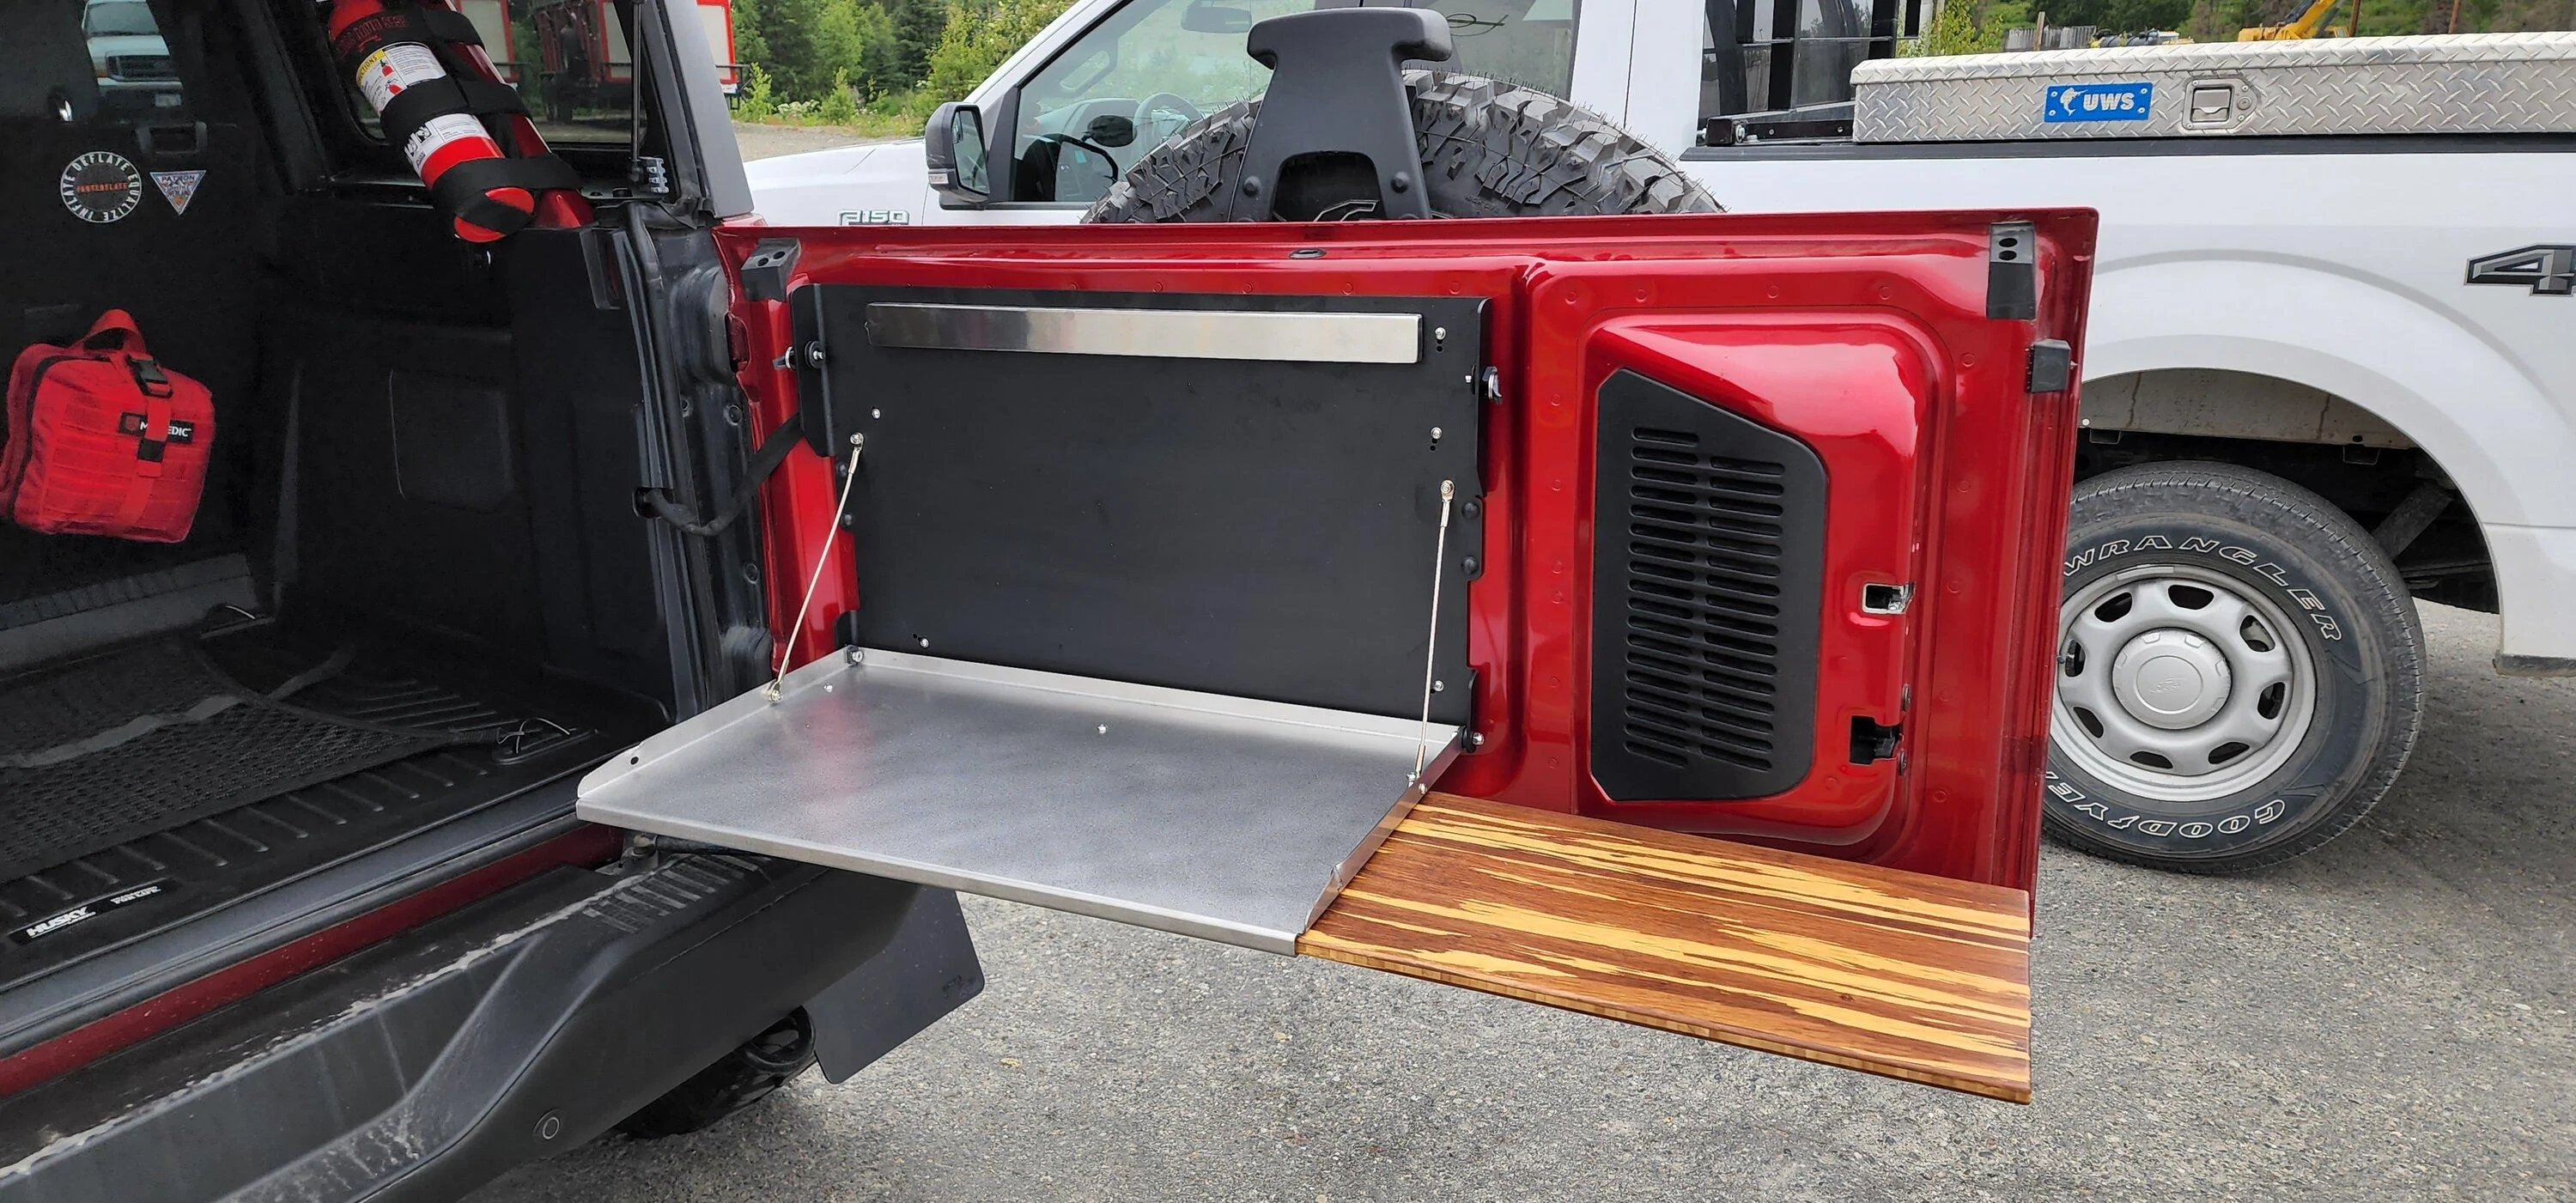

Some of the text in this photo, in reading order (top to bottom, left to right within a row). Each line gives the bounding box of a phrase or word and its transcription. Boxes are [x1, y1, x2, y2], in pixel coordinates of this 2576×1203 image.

[2082, 92, 2136, 111] UWS
[72, 154, 129, 172] DEFLATE
[63, 175, 93, 220] INFLATE
[104, 173, 140, 221] EQUALIZE
[140, 422, 189, 437] MEDIC
[2063, 535, 2342, 641] WRANGLER
[26, 907, 88, 937] HUSKY
